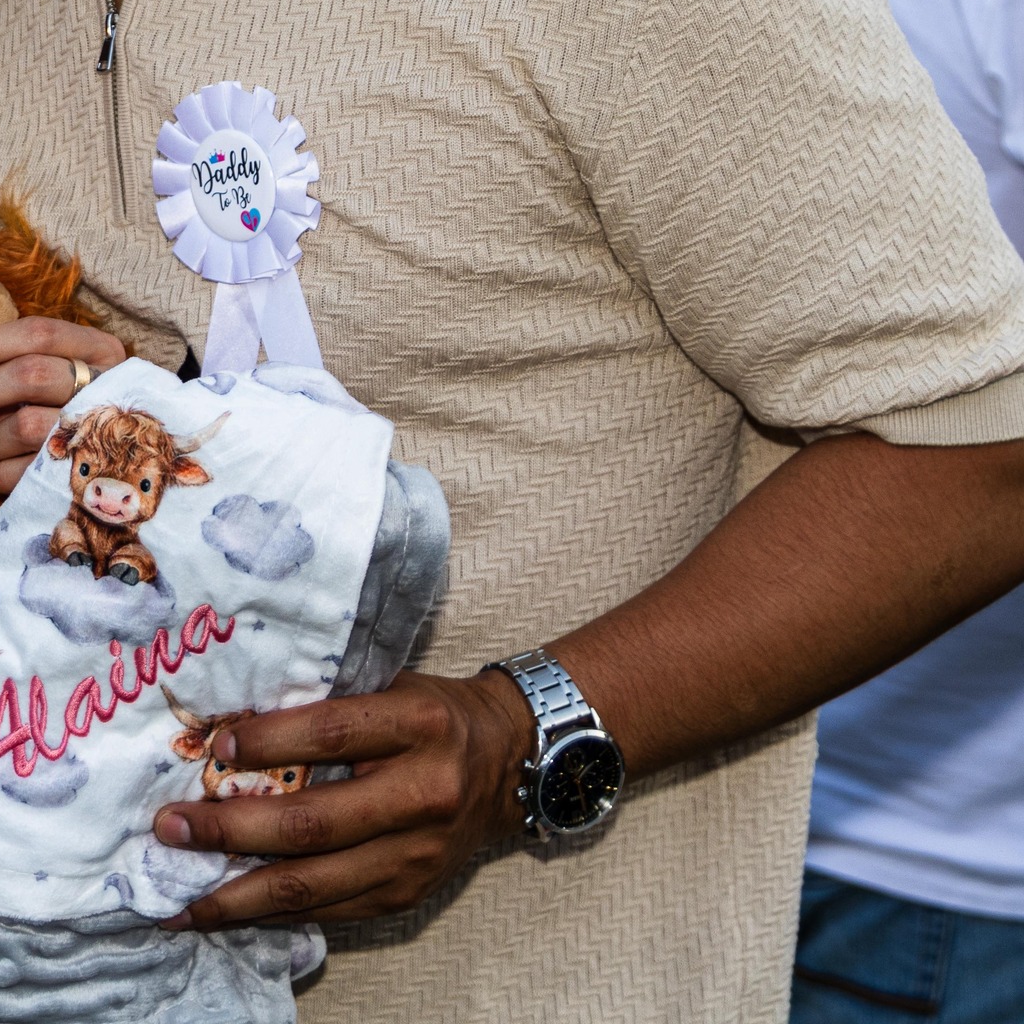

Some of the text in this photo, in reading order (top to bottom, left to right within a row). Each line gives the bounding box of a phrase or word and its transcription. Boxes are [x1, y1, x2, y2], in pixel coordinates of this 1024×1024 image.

[192, 147, 261, 194] Daddy
[212, 186, 252, 211] To Be
